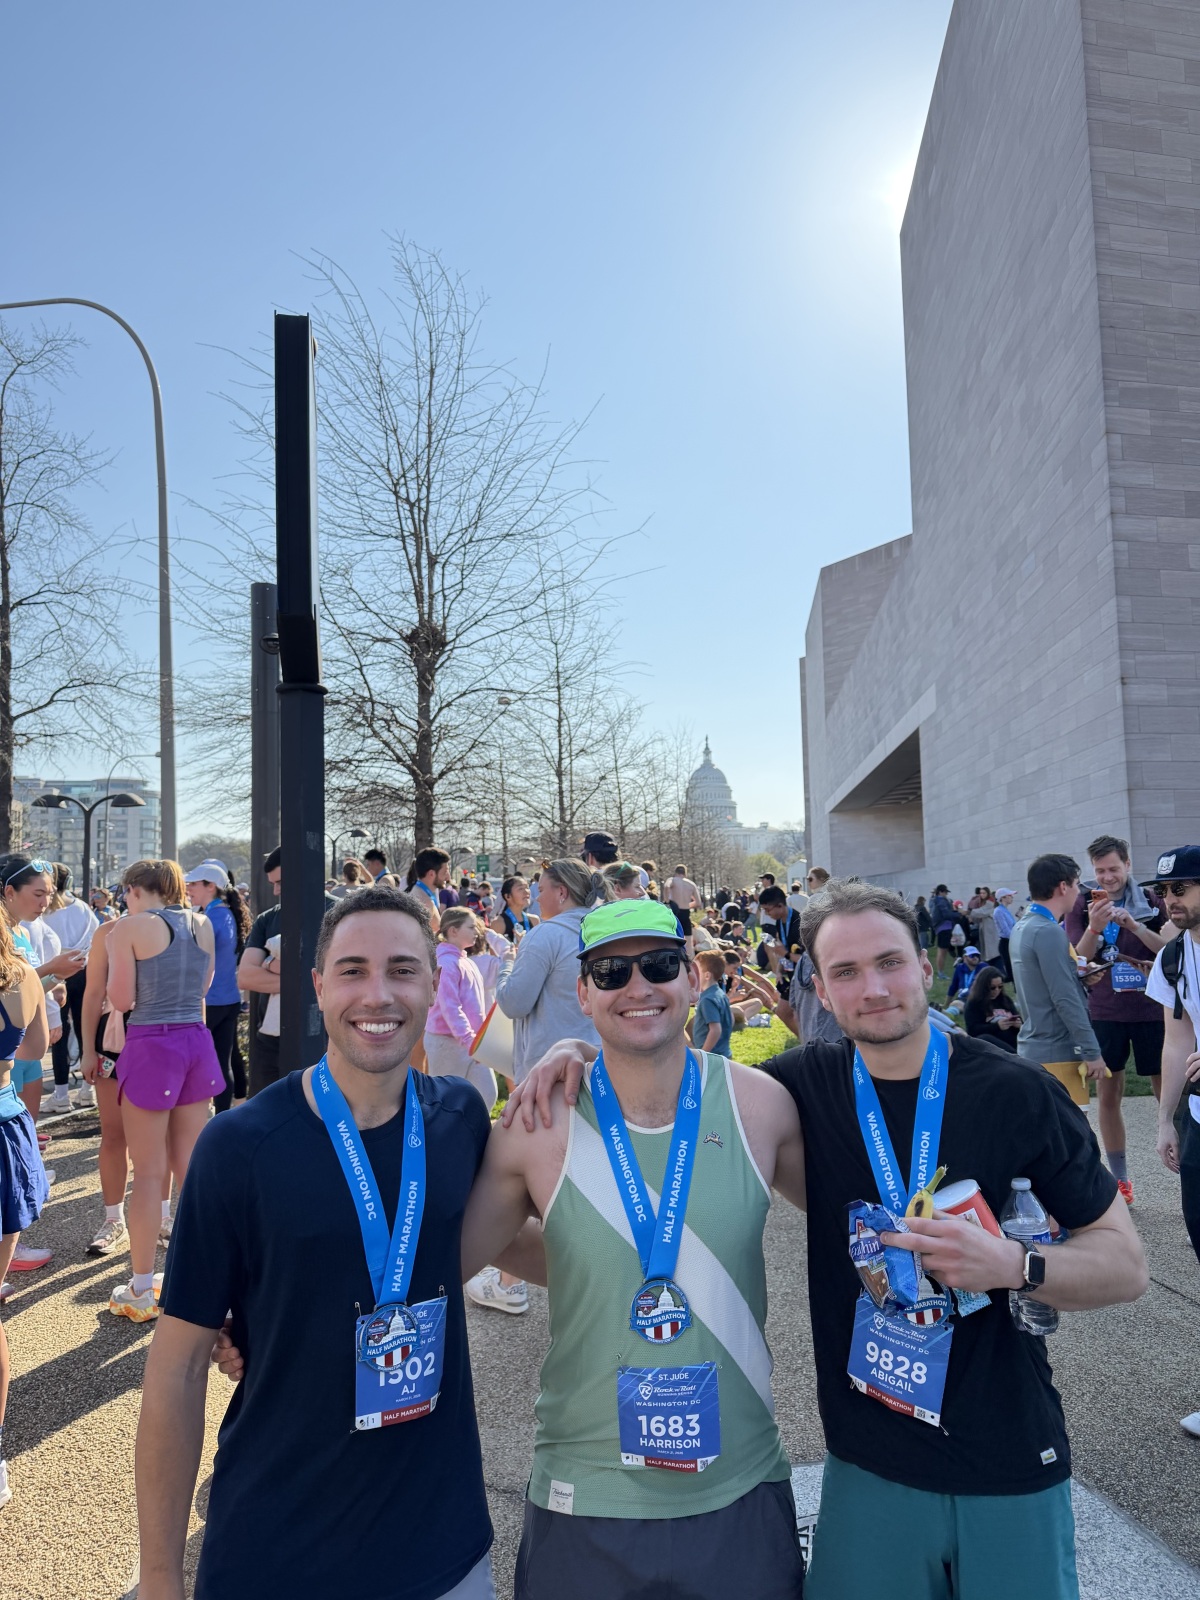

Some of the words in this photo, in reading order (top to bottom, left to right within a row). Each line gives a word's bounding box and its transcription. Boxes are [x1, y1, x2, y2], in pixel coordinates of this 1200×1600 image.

[1114, 975, 1142, 983] 15390
[319, 1074, 330, 1094] JUDE
[855, 1067, 864, 1085] JUDE
[596, 1078, 607, 1098] JUDE
[336, 1120, 372, 1200] WASHINGTON
[365, 1202, 377, 1220] DC
[866, 1111, 896, 1190] WASHINGTON
[890, 1192, 902, 1210] DC
[917, 1131, 931, 1193] ARATHON
[609, 1124, 641, 1204] WASHINGTON
[634, 1204, 647, 1222] DC
[662, 1210, 676, 1243] HALF
[669, 1140, 688, 1208] MARATHON
[391, 1257, 405, 1292] HALF
[398, 1181, 418, 1254] MARATHON
[913, 1300, 948, 1310] MARATHON
[652, 1312, 687, 1323] MARATHON
[885, 1320, 905, 1333] Rock
[366, 1347, 383, 1356] HALF
[383, 1335, 417, 1352] MARATHON
[869, 1327, 916, 1351] WASHINGTON
[918, 1347, 930, 1355] DC
[865, 1341, 928, 1385] 9828
[669, 1373, 690, 1381] JUDE
[870, 1367, 914, 1394] ABIGAIL
[401, 1383, 416, 1395] AJ
[868, 1387, 881, 1397] HALF
[881, 1395, 912, 1412] MARATHON
[383, 1412, 400, 1421] HALF
[400, 1403, 430, 1417] MARATHON
[637, 1413, 701, 1438] 1683
[639, 1437, 701, 1449] HARRISON
[662, 1461, 696, 1469] MARATHON
